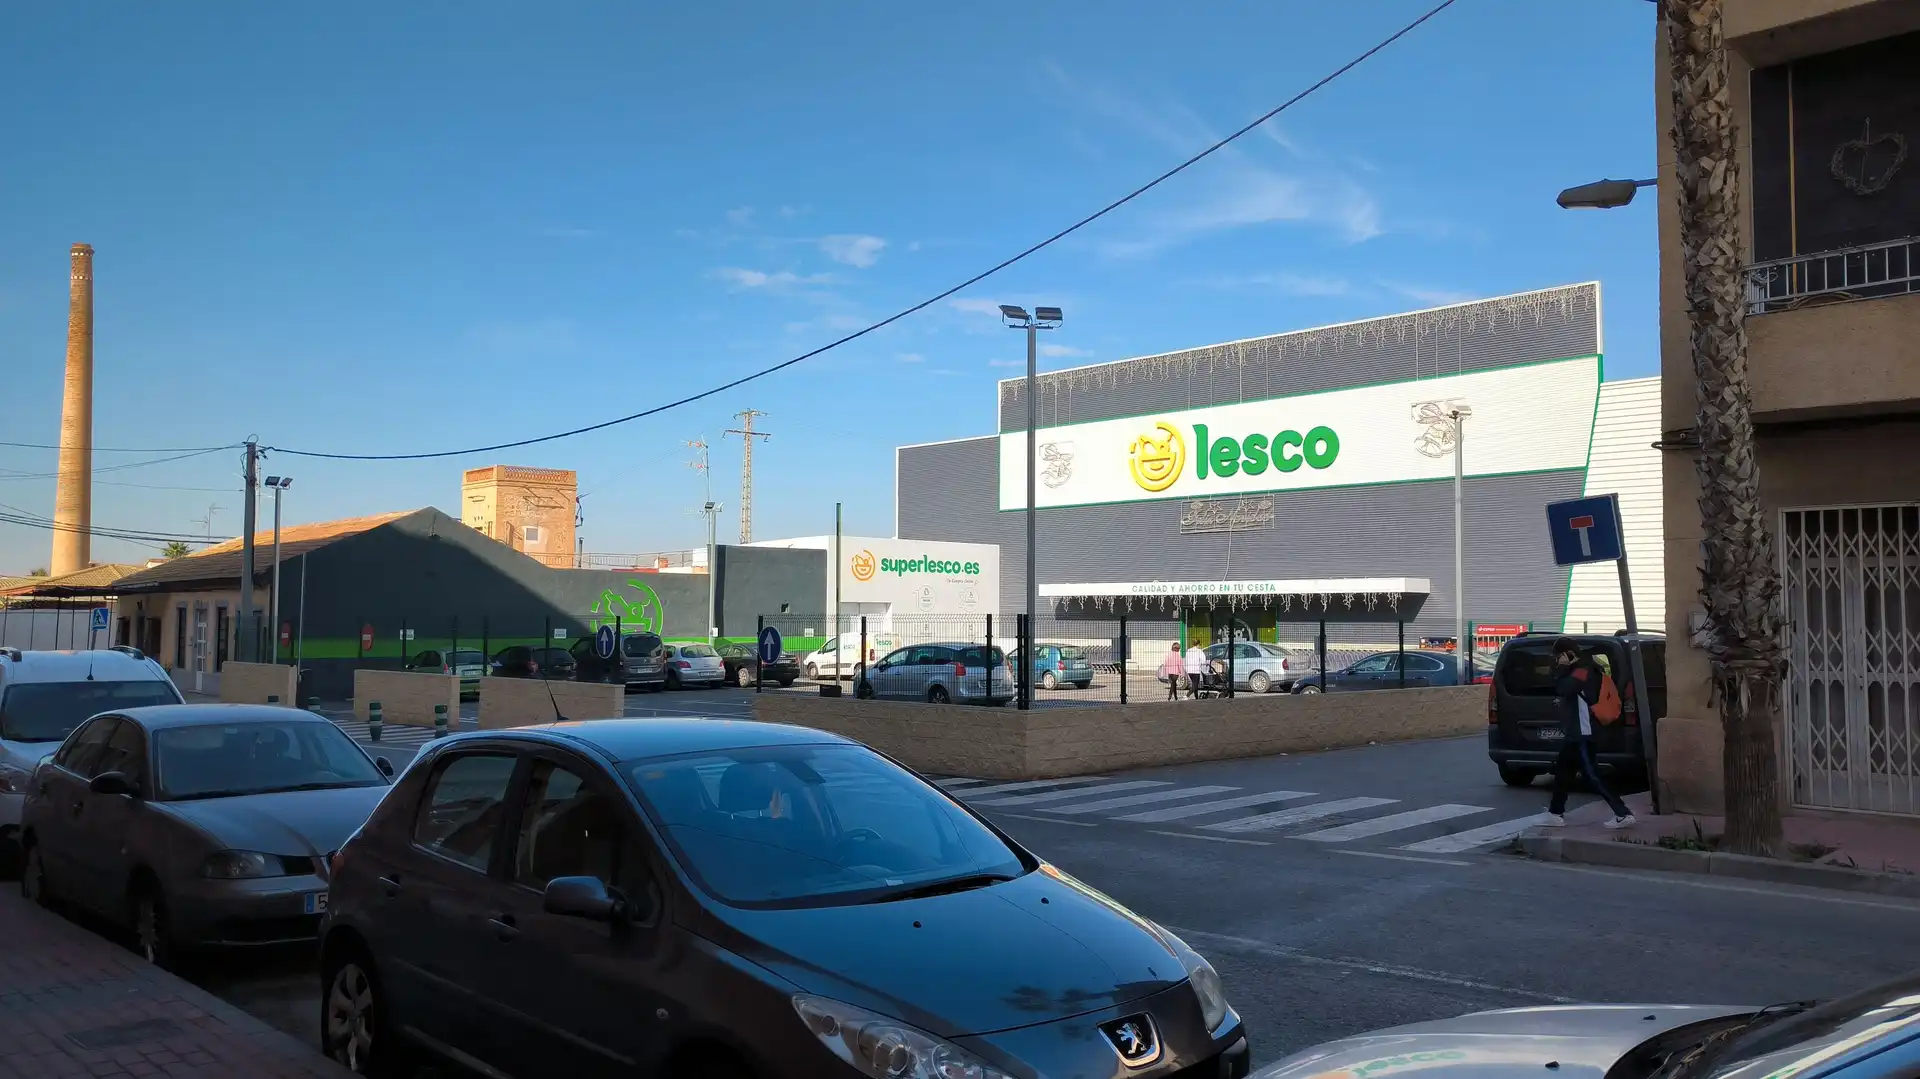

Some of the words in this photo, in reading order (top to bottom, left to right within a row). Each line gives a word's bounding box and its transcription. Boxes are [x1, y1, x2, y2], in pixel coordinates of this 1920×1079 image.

[1192, 423, 1340, 480] lesco
[881, 554, 980, 577] superlesco.es
[1132, 584, 1168, 593] CALIDAD
[1170, 584, 1175, 592] Y
[1178, 584, 1216, 592] AHORRO
[1219, 583, 1230, 592] EN
[1233, 583, 1244, 592] TU
[1247, 583, 1276, 592] CESTA
